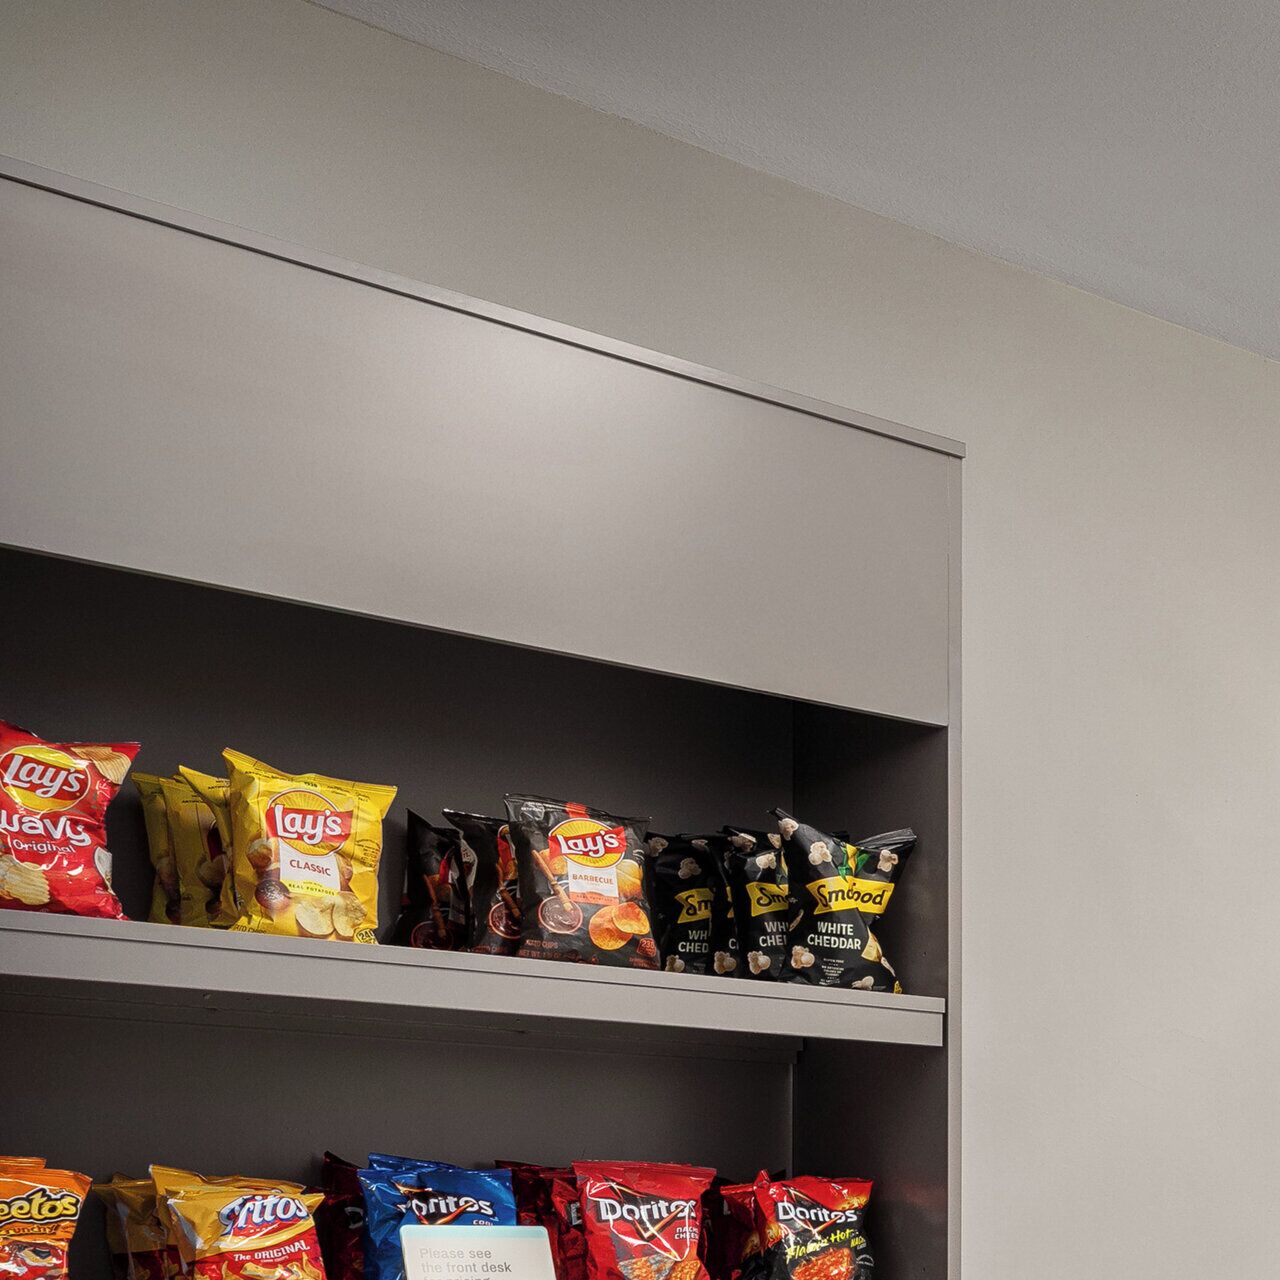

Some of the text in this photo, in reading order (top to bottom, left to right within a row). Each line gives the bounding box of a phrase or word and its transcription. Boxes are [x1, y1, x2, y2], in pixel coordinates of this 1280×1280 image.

[274, 804, 343, 845] Lay's
[13, 839, 76, 854] Original
[556, 830, 621, 857] Lay's
[289, 858, 331, 877] CLASSIC
[572, 873, 614, 885] BARBECUE
[818, 922, 854, 935] WHITE
[807, 934, 861, 950] CHEDDAR
[600, 1198, 699, 1222] Doritos
[778, 1200, 857, 1222] Doritos
[254, 1240, 310, 1261] ORIGINAL
[419, 1248, 491, 1260] Please see
[422, 1261, 512, 1273] the front desk
